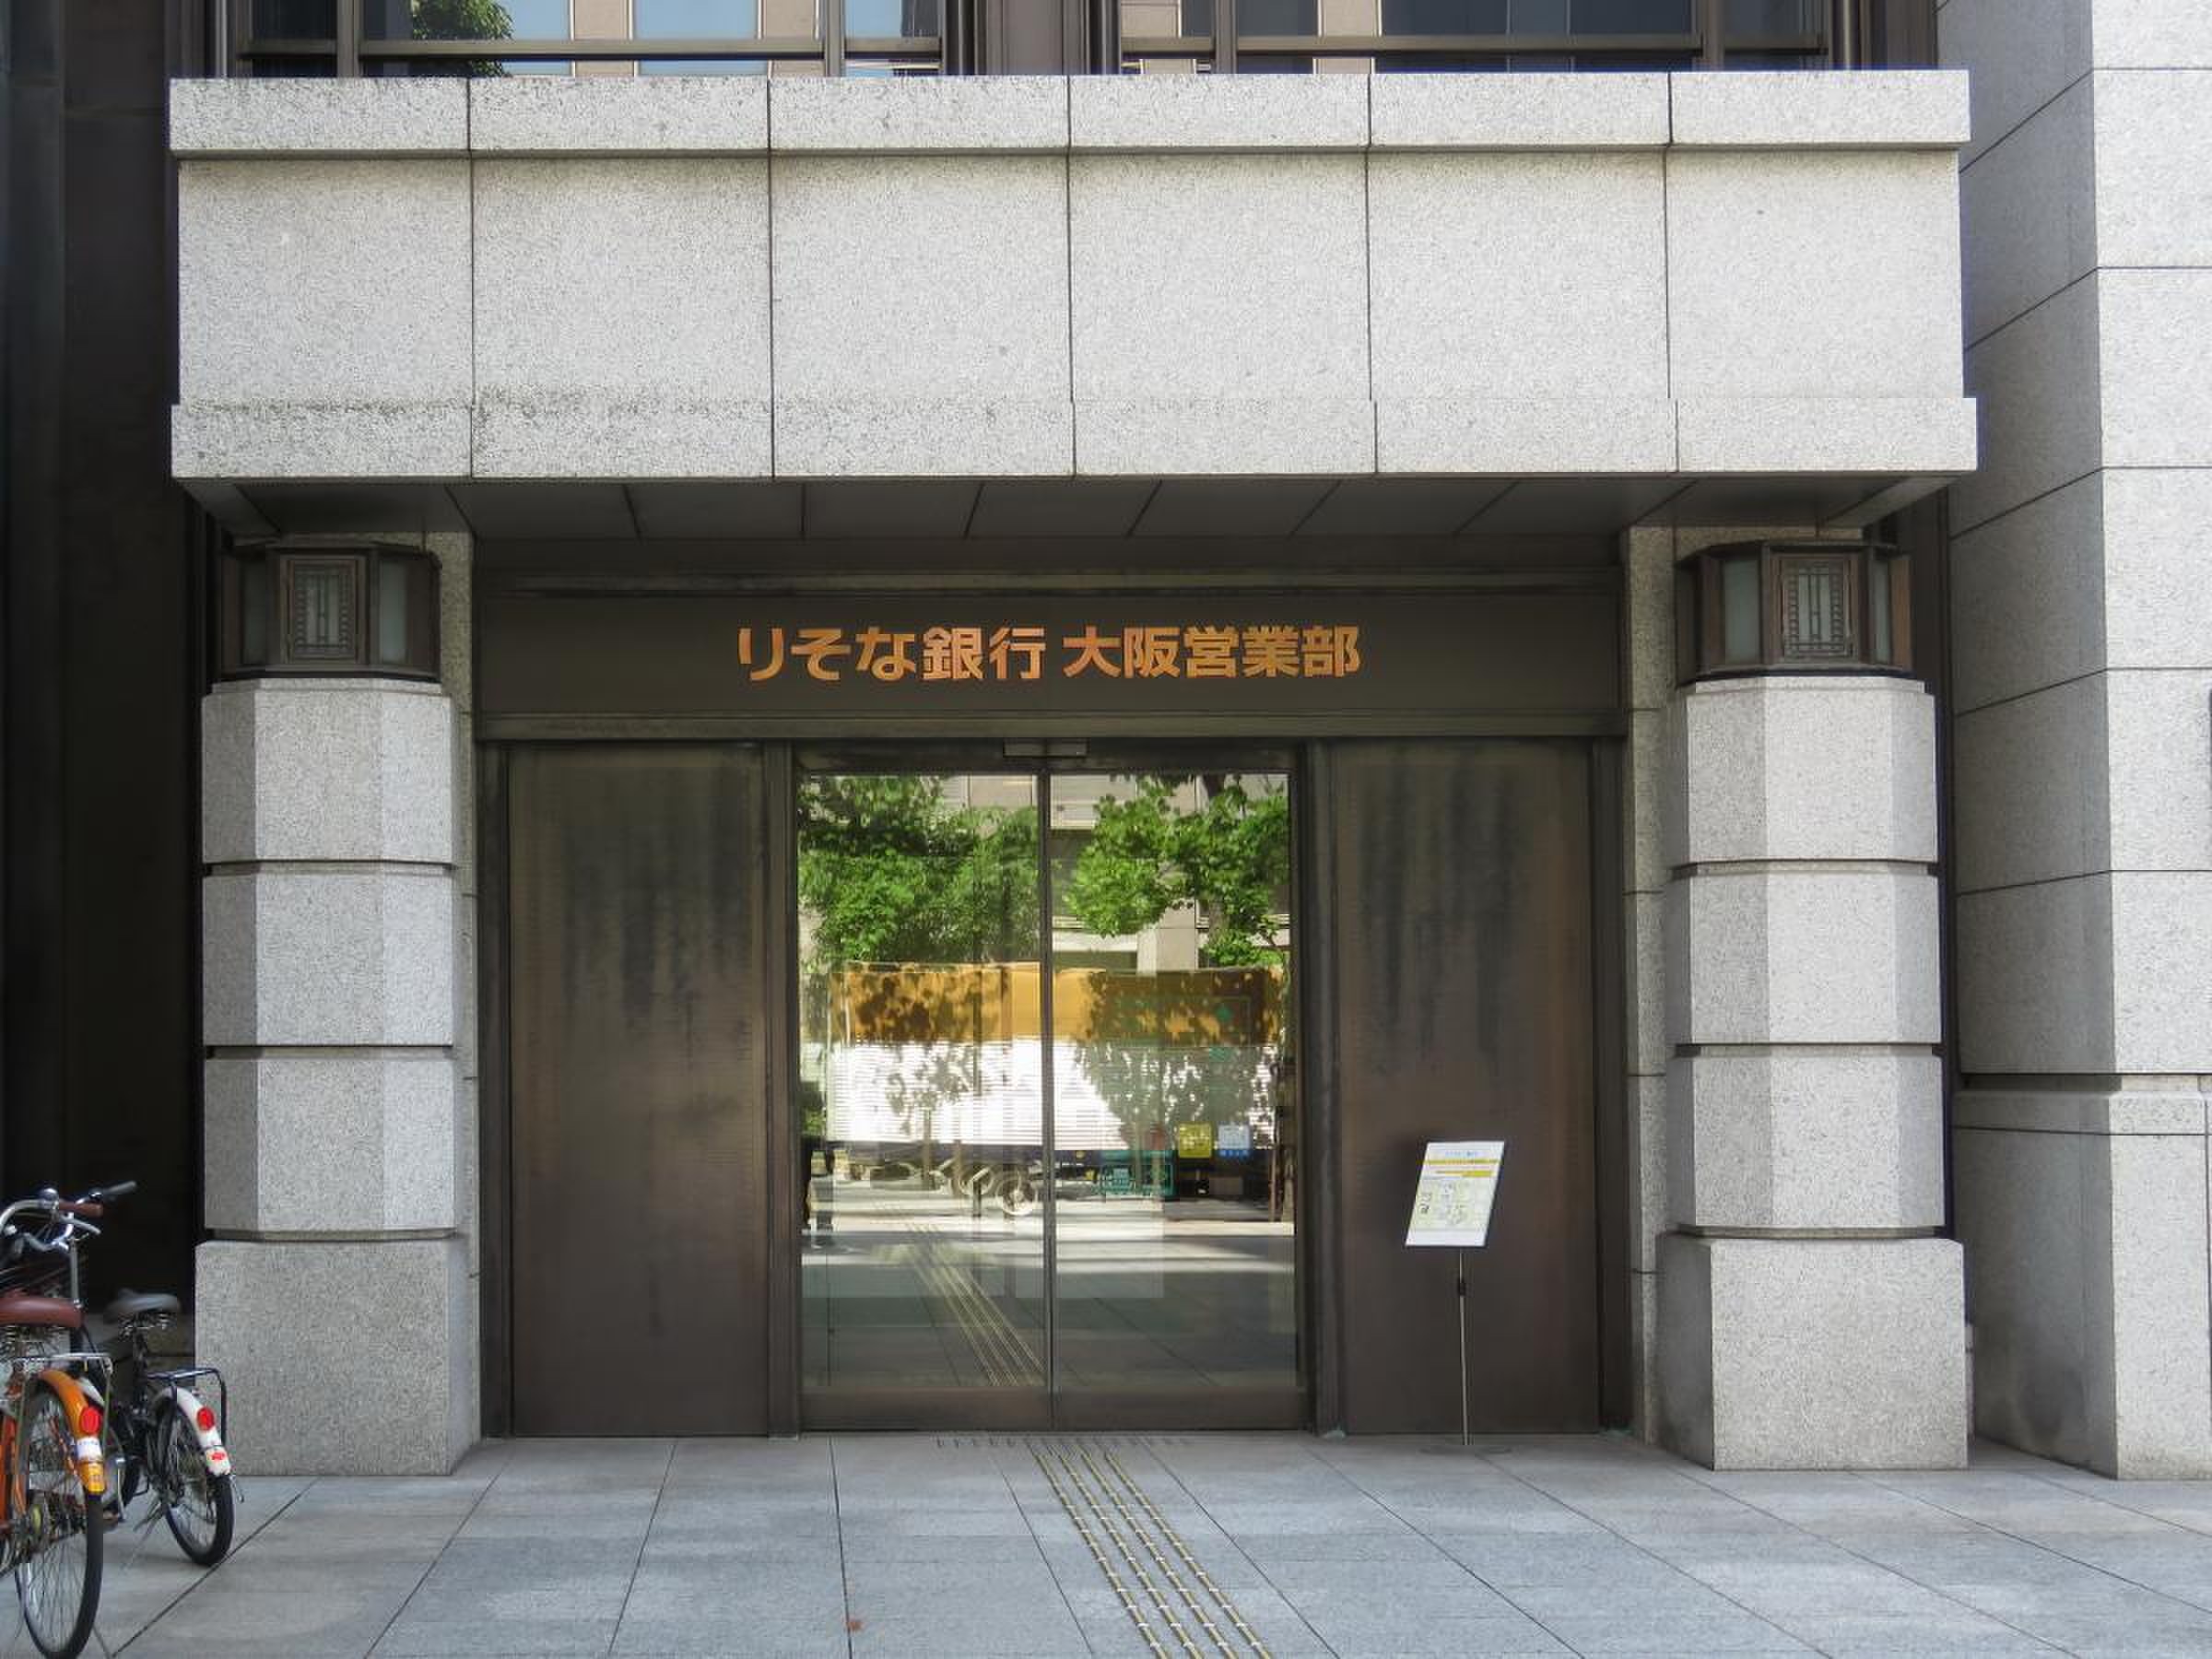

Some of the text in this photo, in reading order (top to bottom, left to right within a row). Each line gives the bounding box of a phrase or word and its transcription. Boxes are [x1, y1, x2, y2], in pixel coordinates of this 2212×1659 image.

[737, 624, 1362, 683] りそな銀行 大阪営業部
